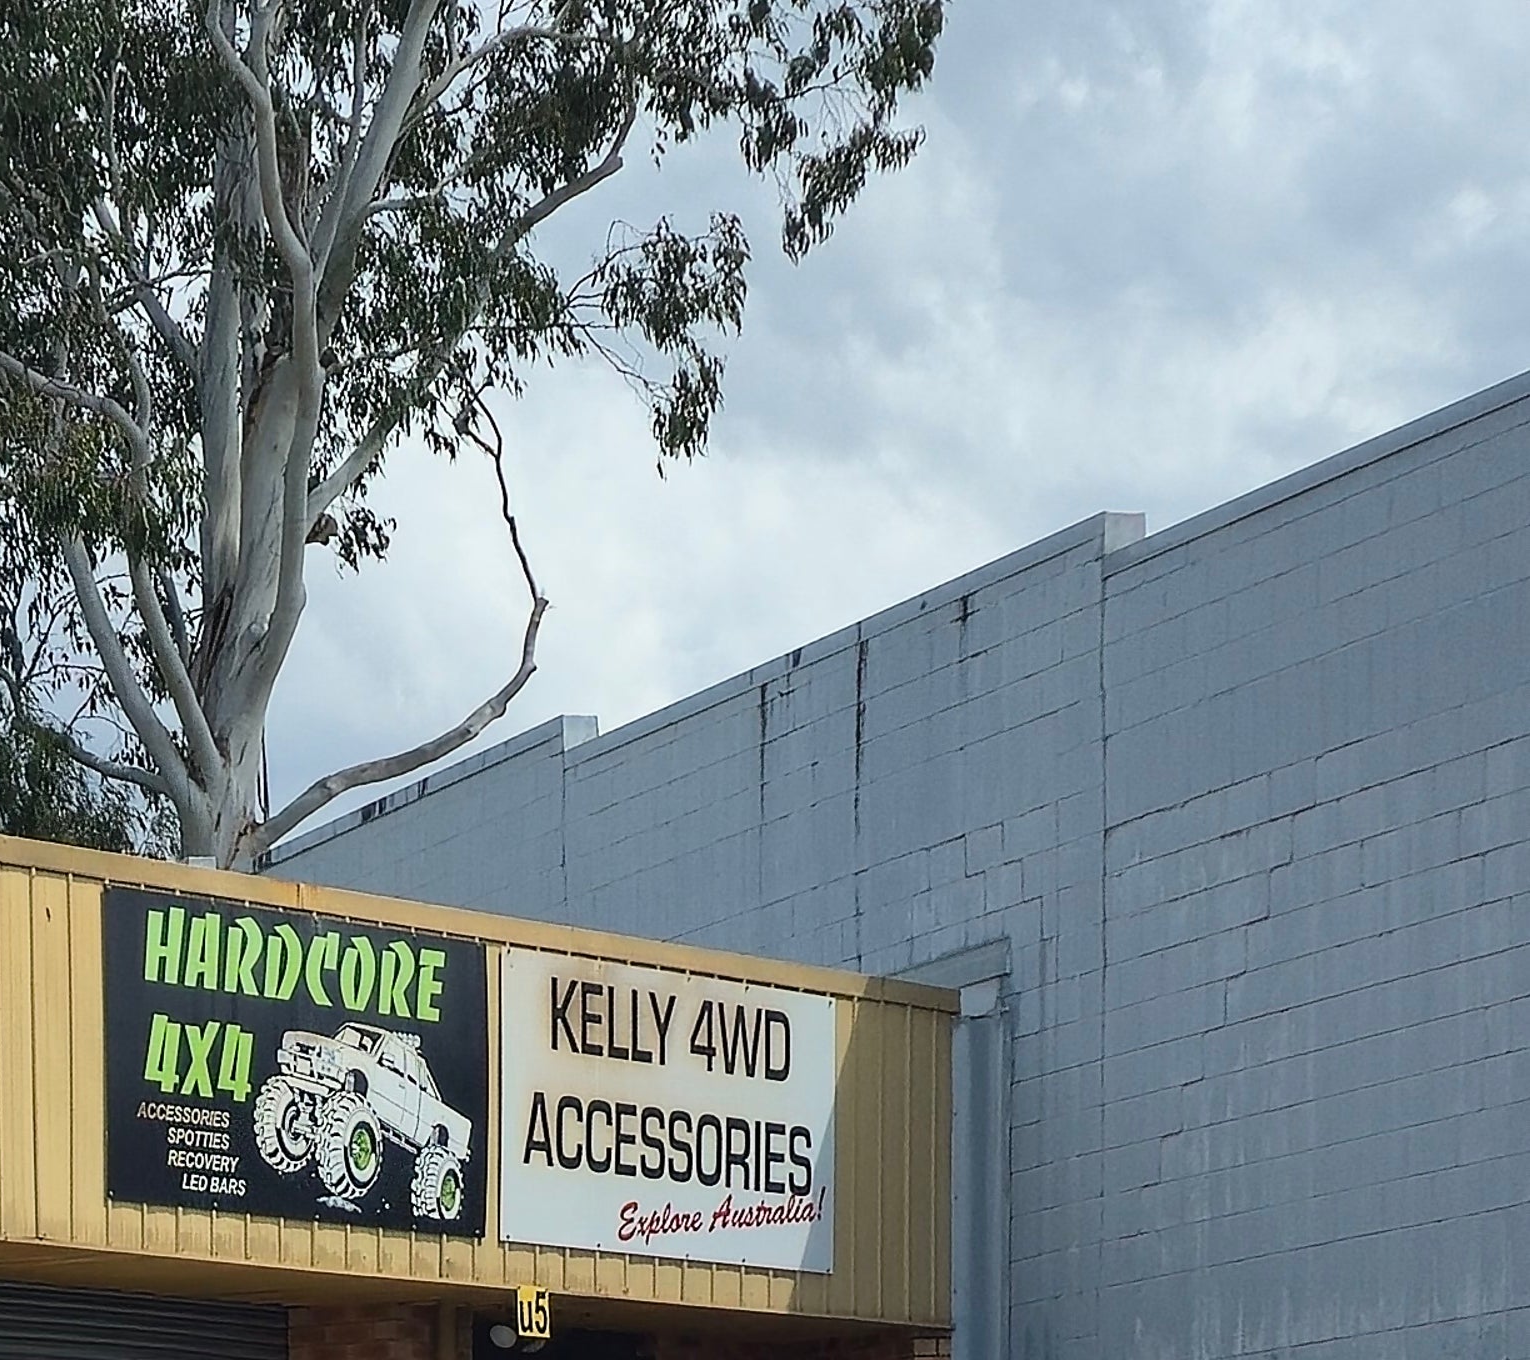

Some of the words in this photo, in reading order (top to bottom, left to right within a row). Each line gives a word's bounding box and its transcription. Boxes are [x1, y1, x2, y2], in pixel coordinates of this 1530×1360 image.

[144, 906, 446, 1022] HARDCORE
[551, 976, 676, 1065] KELLY
[690, 1000, 791, 1082] 4WD
[144, 1013, 253, 1101] 4X4
[137, 1102, 230, 1128] ACCESSORIES
[167, 1127, 230, 1150] SPOTTIES
[167, 1149, 239, 1173] RECOVERY
[523, 1091, 812, 1196] ACCESSORIES
[182, 1173, 208, 1191] LED
[210, 1176, 247, 1196] BARS
[618, 1201, 703, 1245] Explore
[709, 1186, 826, 1232] Australia!
[519, 1291, 548, 1334] u5
